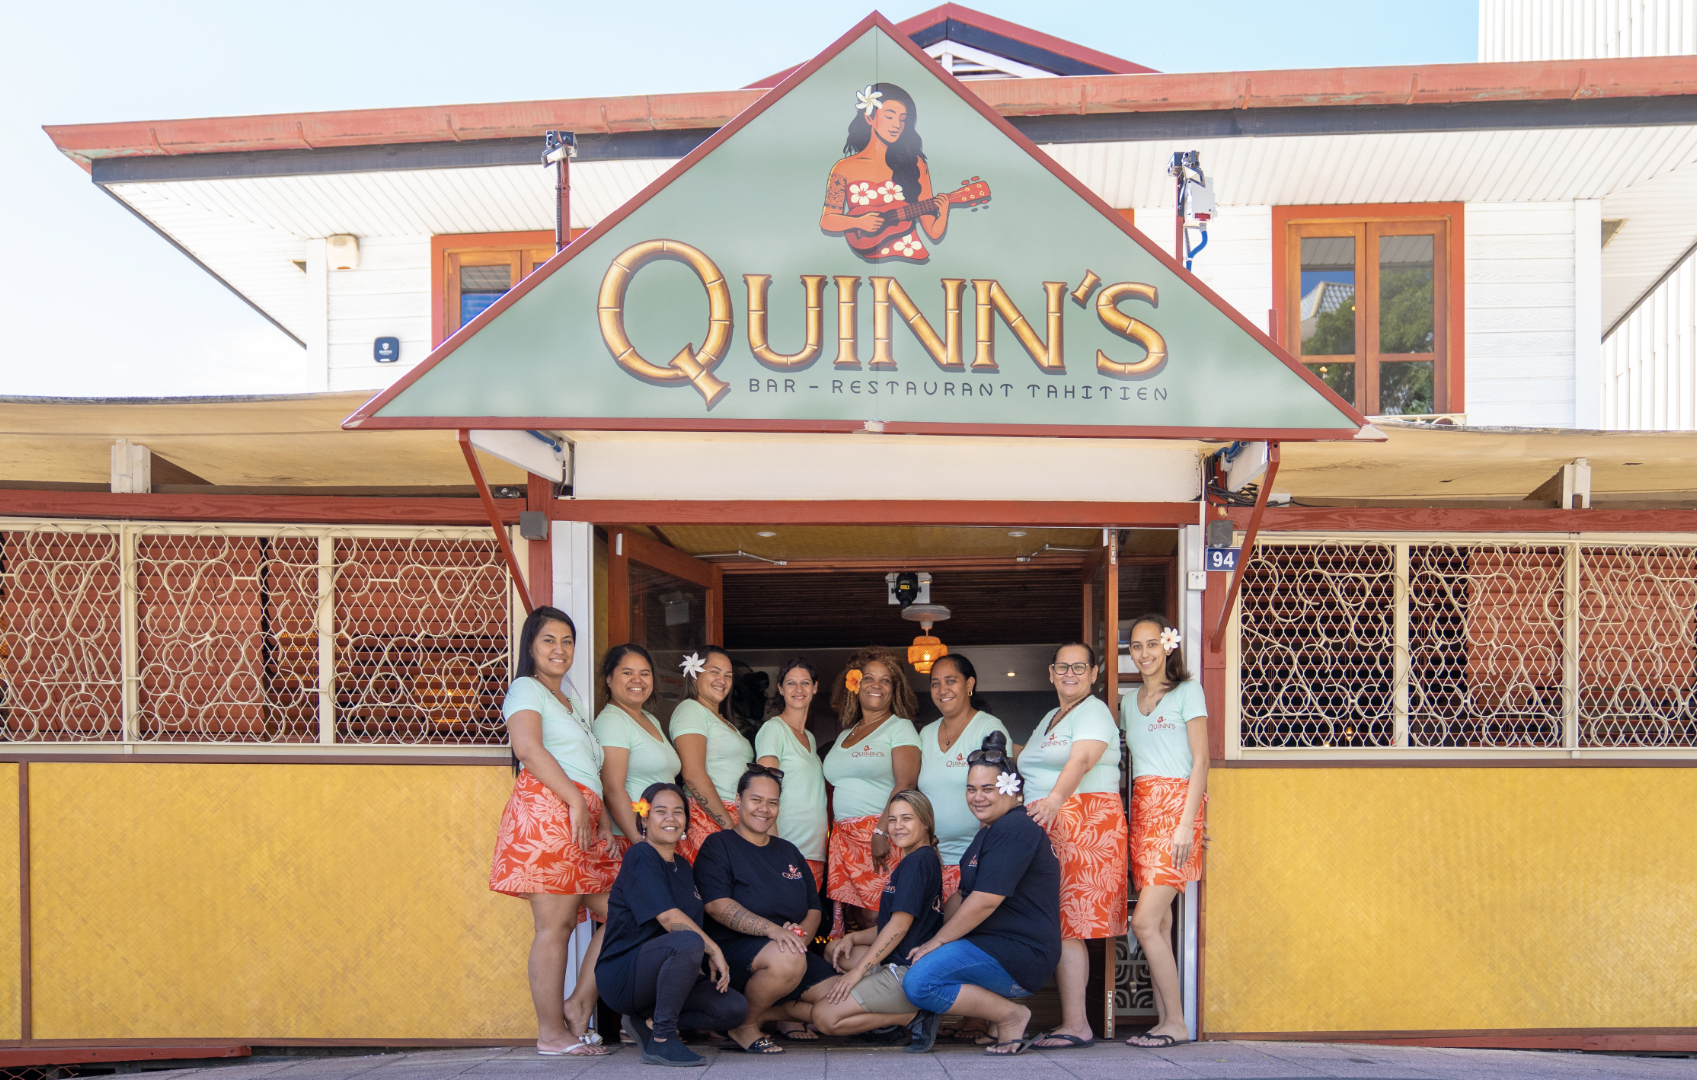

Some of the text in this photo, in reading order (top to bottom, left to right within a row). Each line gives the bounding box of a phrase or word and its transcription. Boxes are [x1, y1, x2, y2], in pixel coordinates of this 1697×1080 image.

[597, 238, 1168, 410] QUINN'S
[749, 378, 796, 393] BAR
[831, 379, 1014, 397] RESTAURANT
[1026, 384, 1168, 401] TAHITIEN
[1212, 551, 1235, 568] 94
